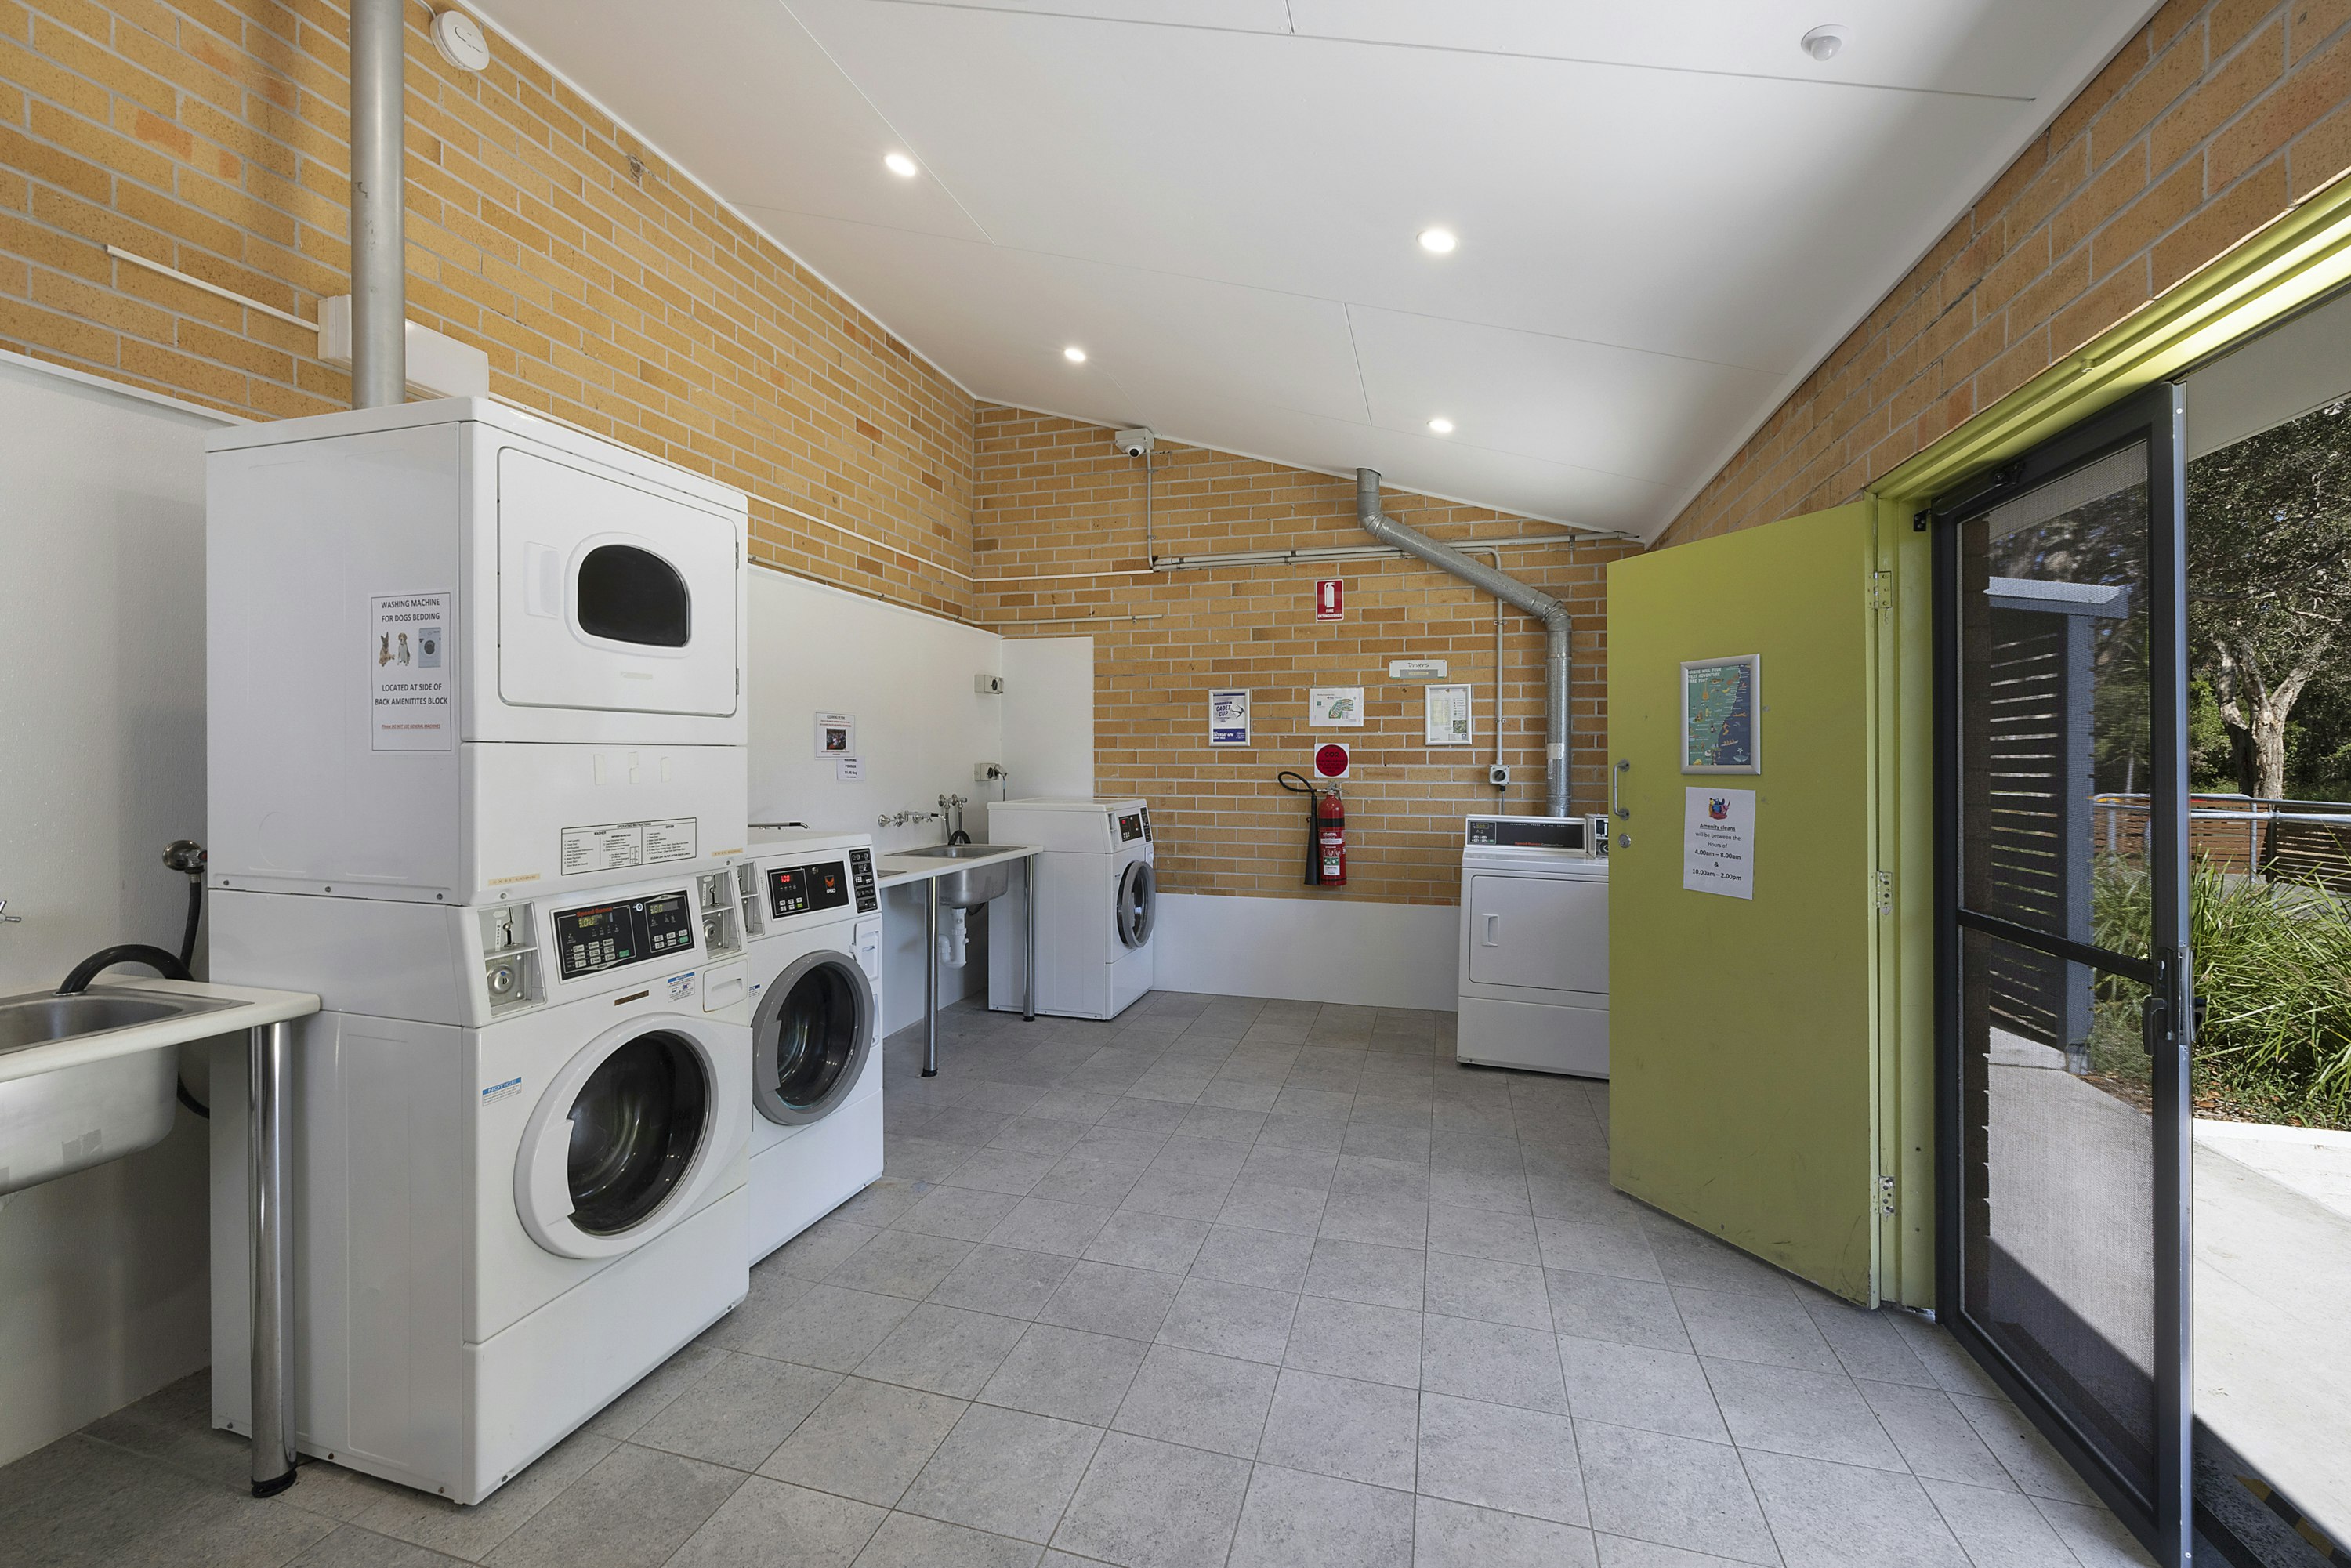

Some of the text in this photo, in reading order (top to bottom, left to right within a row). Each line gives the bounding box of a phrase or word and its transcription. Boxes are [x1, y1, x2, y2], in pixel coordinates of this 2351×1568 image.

[381, 598, 440, 609] WASHING MACHINE
[1692, 868, 1715, 877] 10.00am
[1720, 872, 1742, 881] 2.00pm
[487, 1081, 515, 1093] NOTICE
